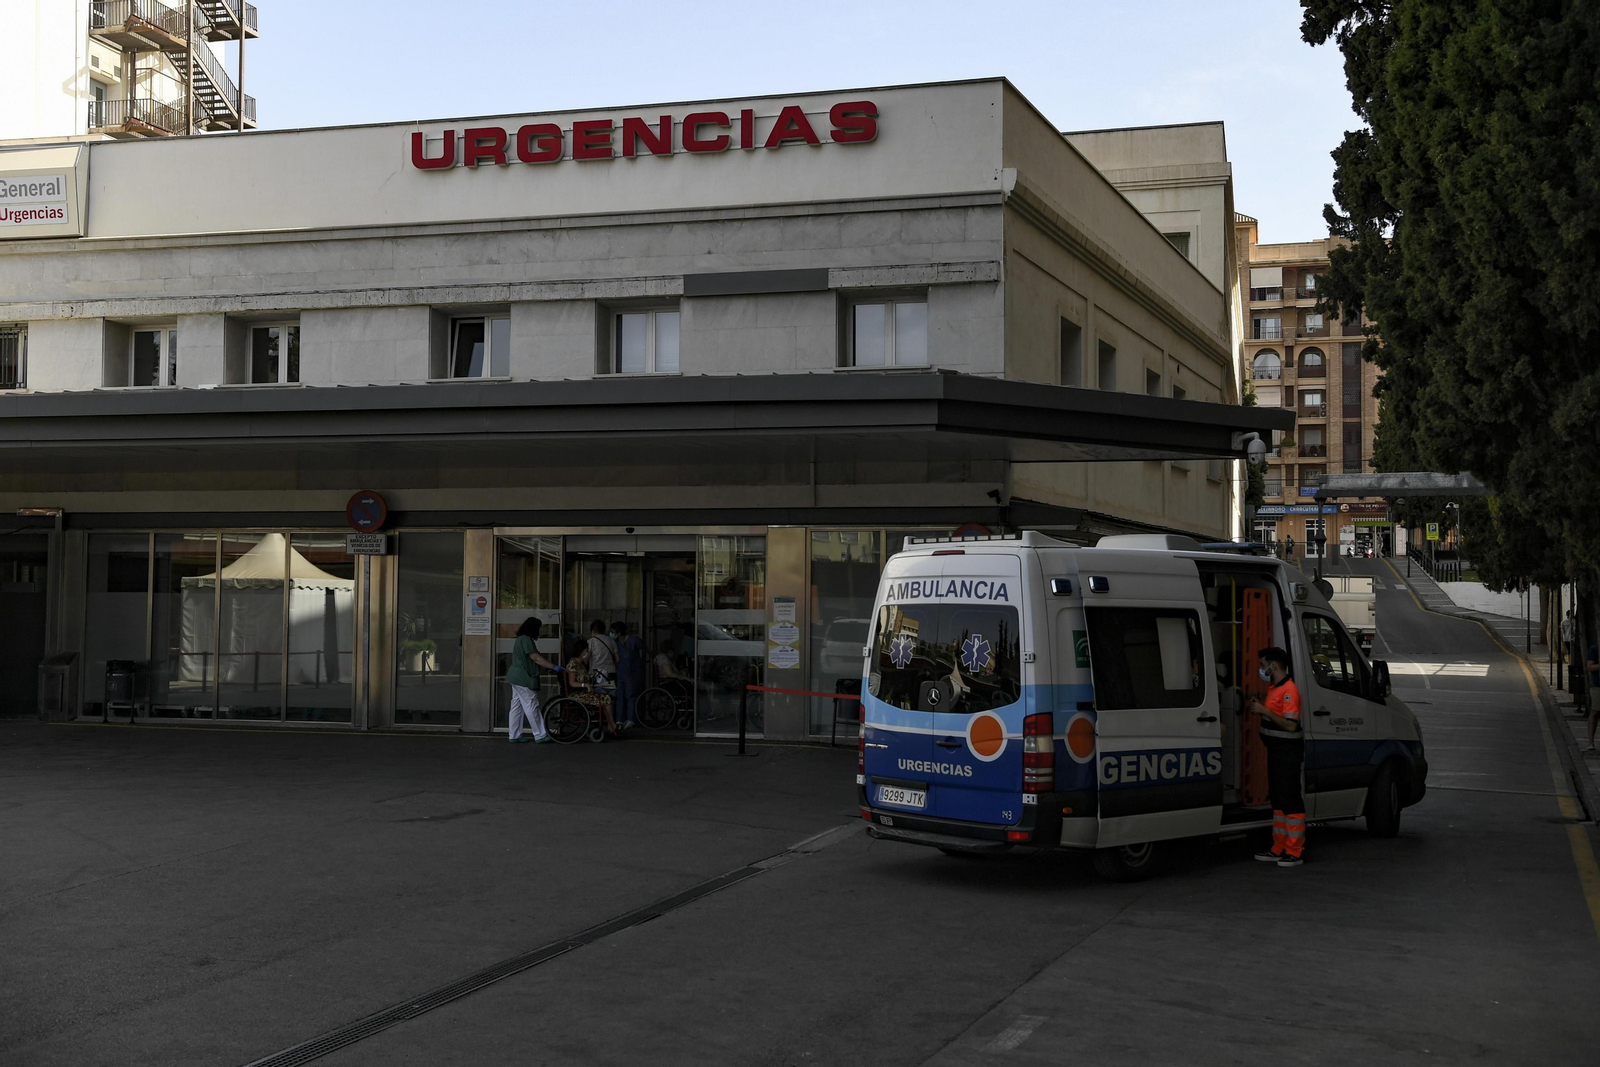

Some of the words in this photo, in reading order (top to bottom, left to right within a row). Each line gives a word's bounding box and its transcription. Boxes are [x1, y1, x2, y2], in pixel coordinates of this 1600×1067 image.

[411, 101, 878, 170] URGENCIAS
[0, 177, 60, 198] General
[0, 206, 64, 223] Urgencias
[886, 580, 1009, 601] AMBULANCIA
[898, 758, 973, 777] URGENCIAS
[884, 789, 904, 803] 9299
[907, 794, 924, 806] JTK
